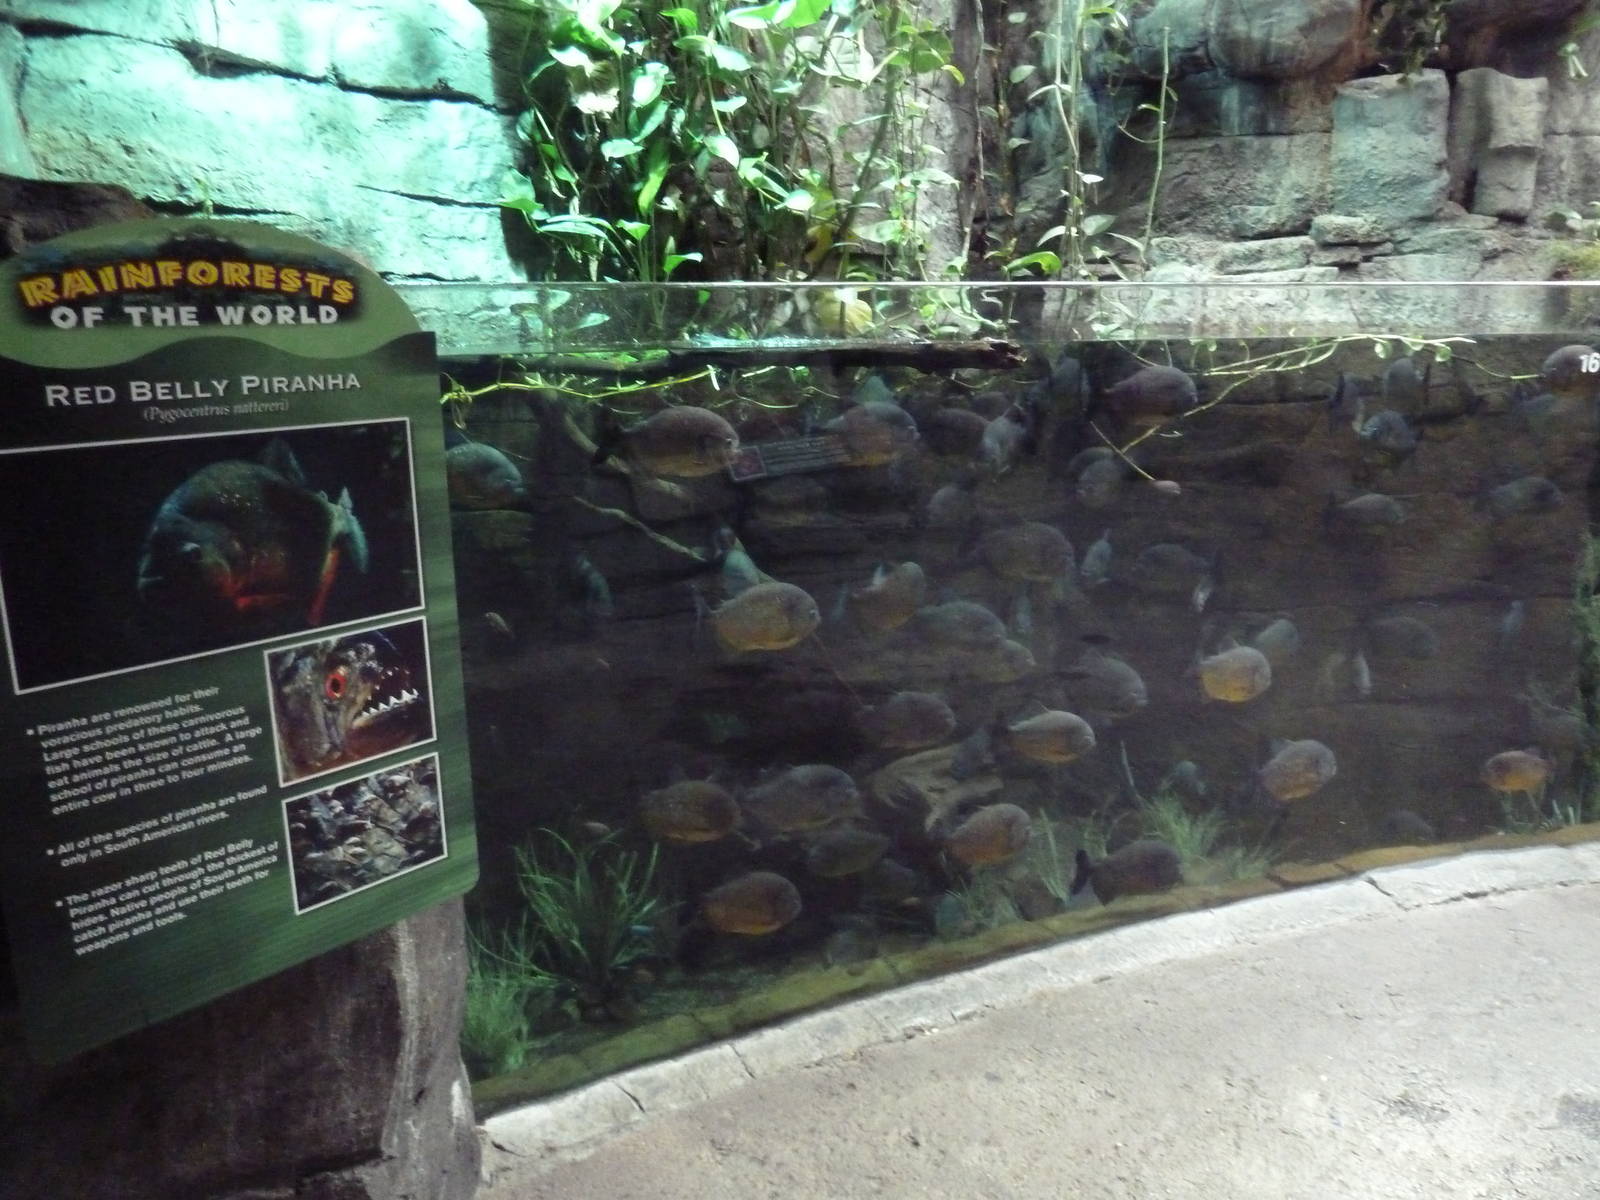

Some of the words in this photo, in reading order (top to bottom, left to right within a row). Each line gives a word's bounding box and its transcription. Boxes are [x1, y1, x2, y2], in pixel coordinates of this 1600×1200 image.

[18, 260, 355, 307] RAINFORESTS
[50, 306, 103, 329] OF
[124, 306, 199, 327] THE
[217, 305, 338, 326] WORLD
[1579, 351, 1600, 373] 16
[46, 385, 116, 407] RED
[129, 379, 229, 402] BELLY
[241, 374, 361, 395] PIRANHA
